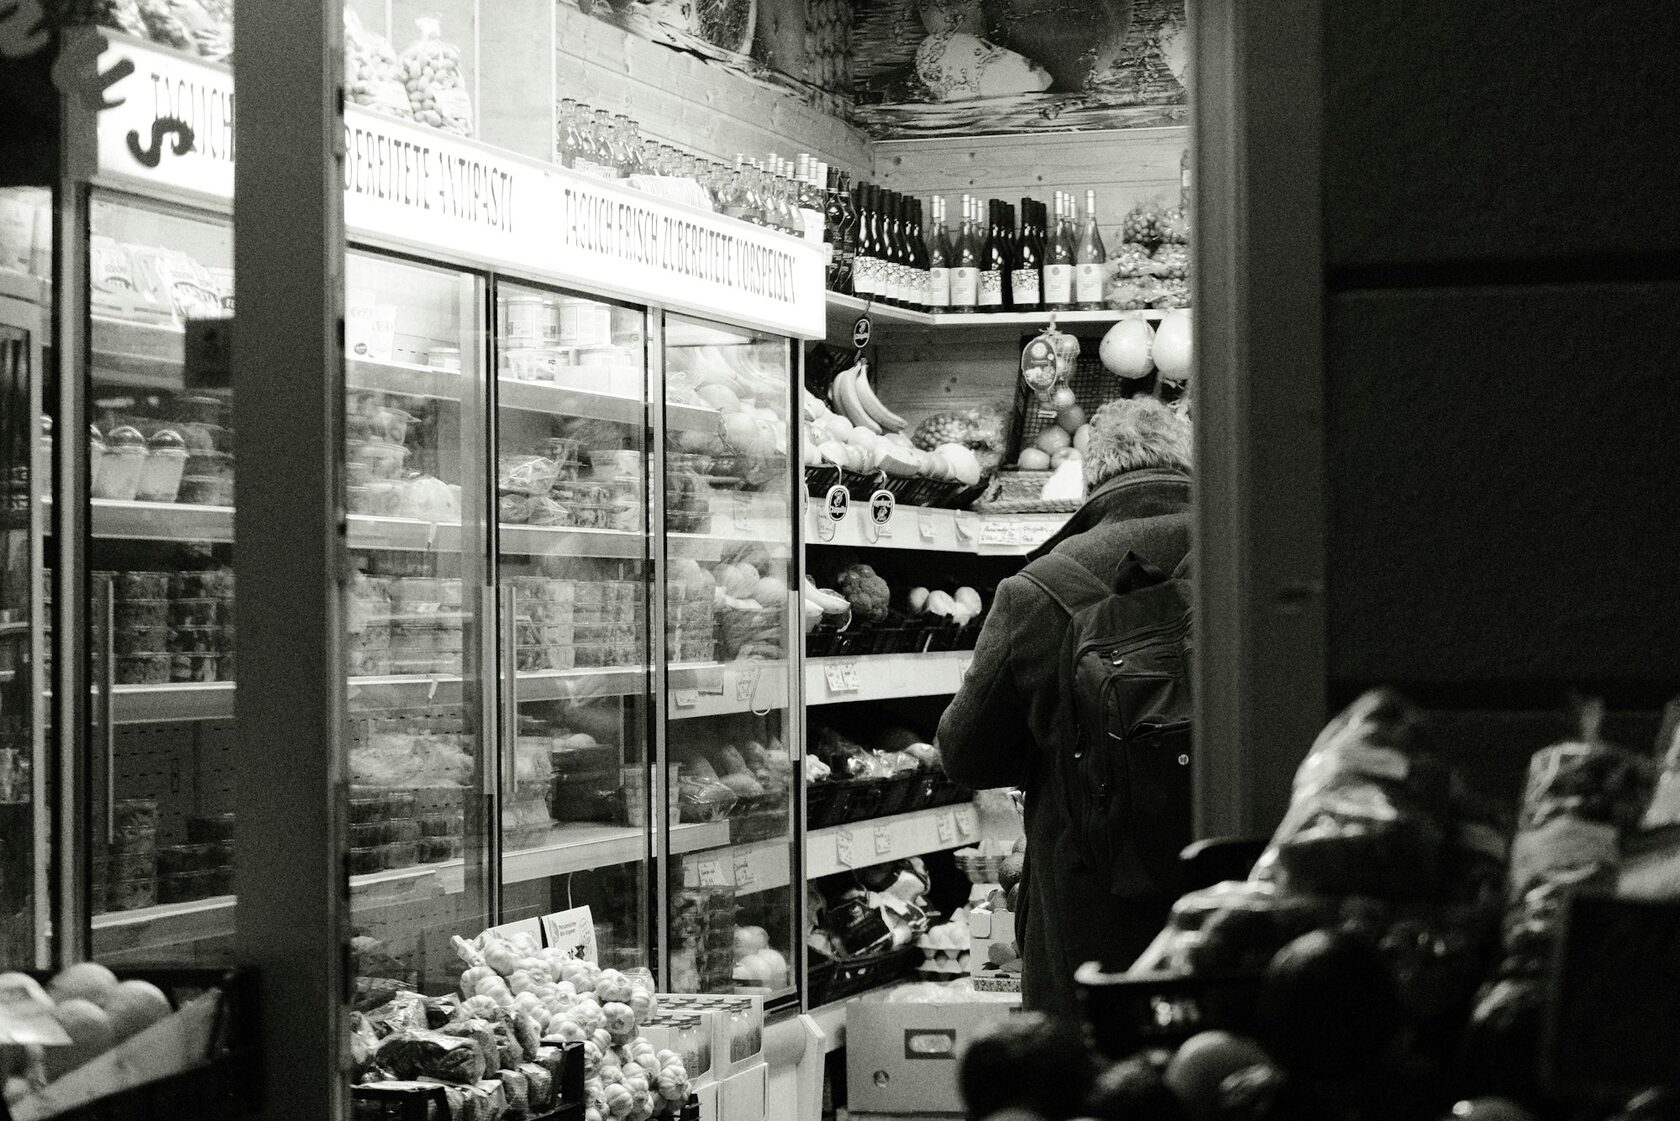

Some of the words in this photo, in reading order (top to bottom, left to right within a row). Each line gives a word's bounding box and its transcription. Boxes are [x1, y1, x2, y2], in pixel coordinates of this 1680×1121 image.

[438, 151, 513, 233] ANTIPASTI
[618, 203, 659, 266] FRISCH
[663, 216, 734, 287] ZUBEREITETE
[736, 237, 796, 304] VORSPEISEN
